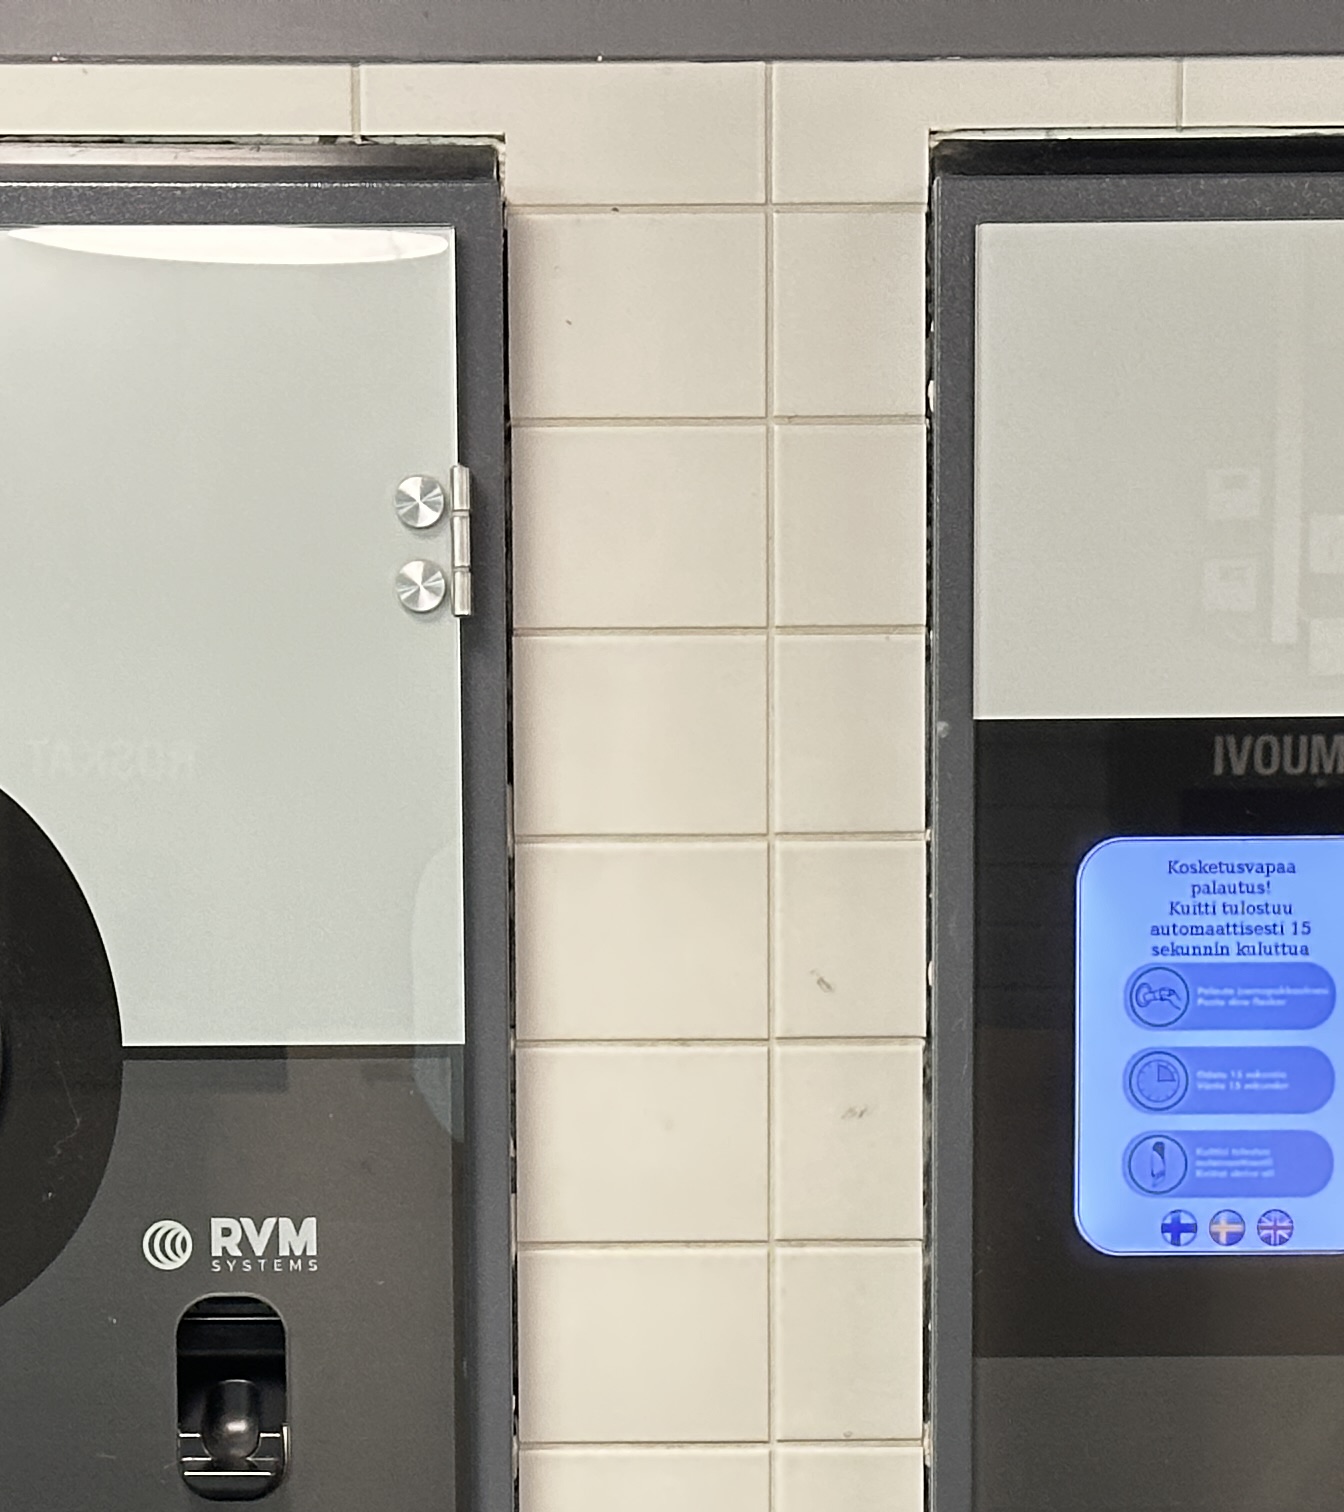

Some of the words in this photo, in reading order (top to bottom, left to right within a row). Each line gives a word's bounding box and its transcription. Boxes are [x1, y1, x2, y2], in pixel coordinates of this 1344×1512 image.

[1167, 860, 1297, 878] Kosketusvapaa
[1191, 880, 1271, 898] palautus!
[1168, 901, 1217, 916] Kuitti
[1222, 901, 1293, 916] tulostuu
[1150, 921, 1285, 936] automaattisesti
[1292, 921, 1312, 936] 15
[1151, 941, 1230, 957] sekunnin
[1236, 941, 1310, 957] kuluttua
[211, 1217, 318, 1257] RVM
[211, 1259, 318, 1272] SYSTEMS
